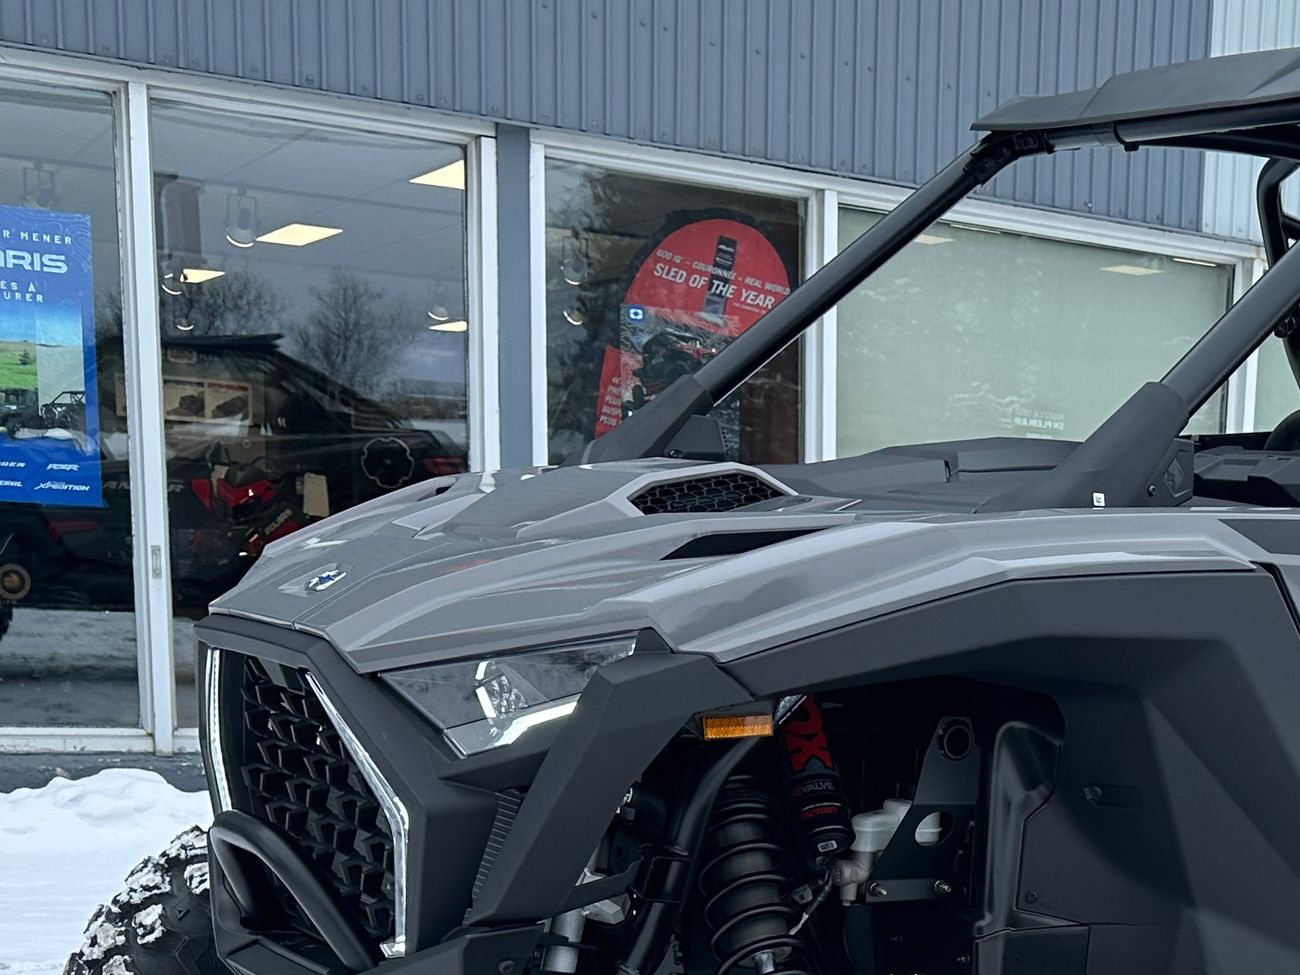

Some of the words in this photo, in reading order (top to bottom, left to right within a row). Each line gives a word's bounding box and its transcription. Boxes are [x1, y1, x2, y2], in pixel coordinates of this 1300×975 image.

[20, 231, 72, 245] MENER
[0, 249, 68, 274] RIS
[653, 263, 686, 283] SLED
[689, 272, 709, 289] OF
[710, 280, 735, 298] THE
[741, 288, 776, 310] YEAR
[692, 261, 737, 281] COURONNÉE
[745, 277, 762, 289] REAL
[764, 282, 791, 296] WORLD
